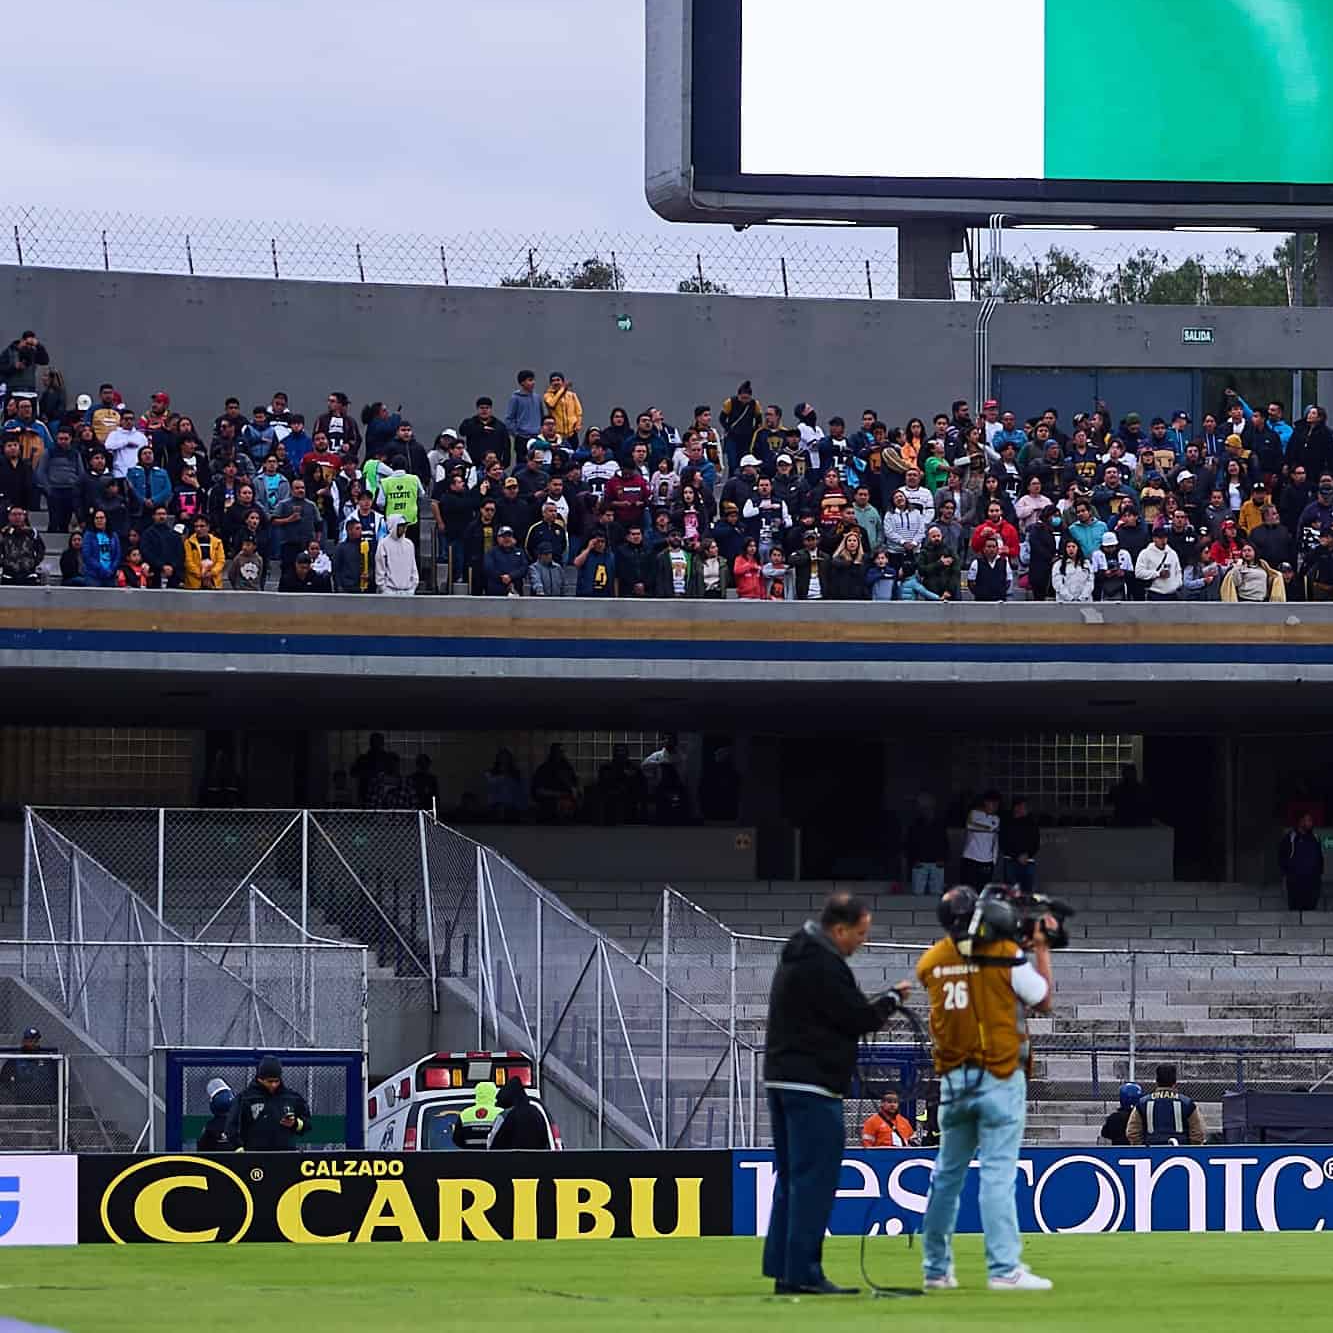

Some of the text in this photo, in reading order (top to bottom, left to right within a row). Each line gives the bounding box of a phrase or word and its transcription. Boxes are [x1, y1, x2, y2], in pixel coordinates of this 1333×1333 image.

[1184, 330, 1211, 341] SALIDA
[943, 981, 969, 1011] 26
[301, 1160, 404, 1176] CALZADO
[276, 1177, 704, 1243] CARIBU
